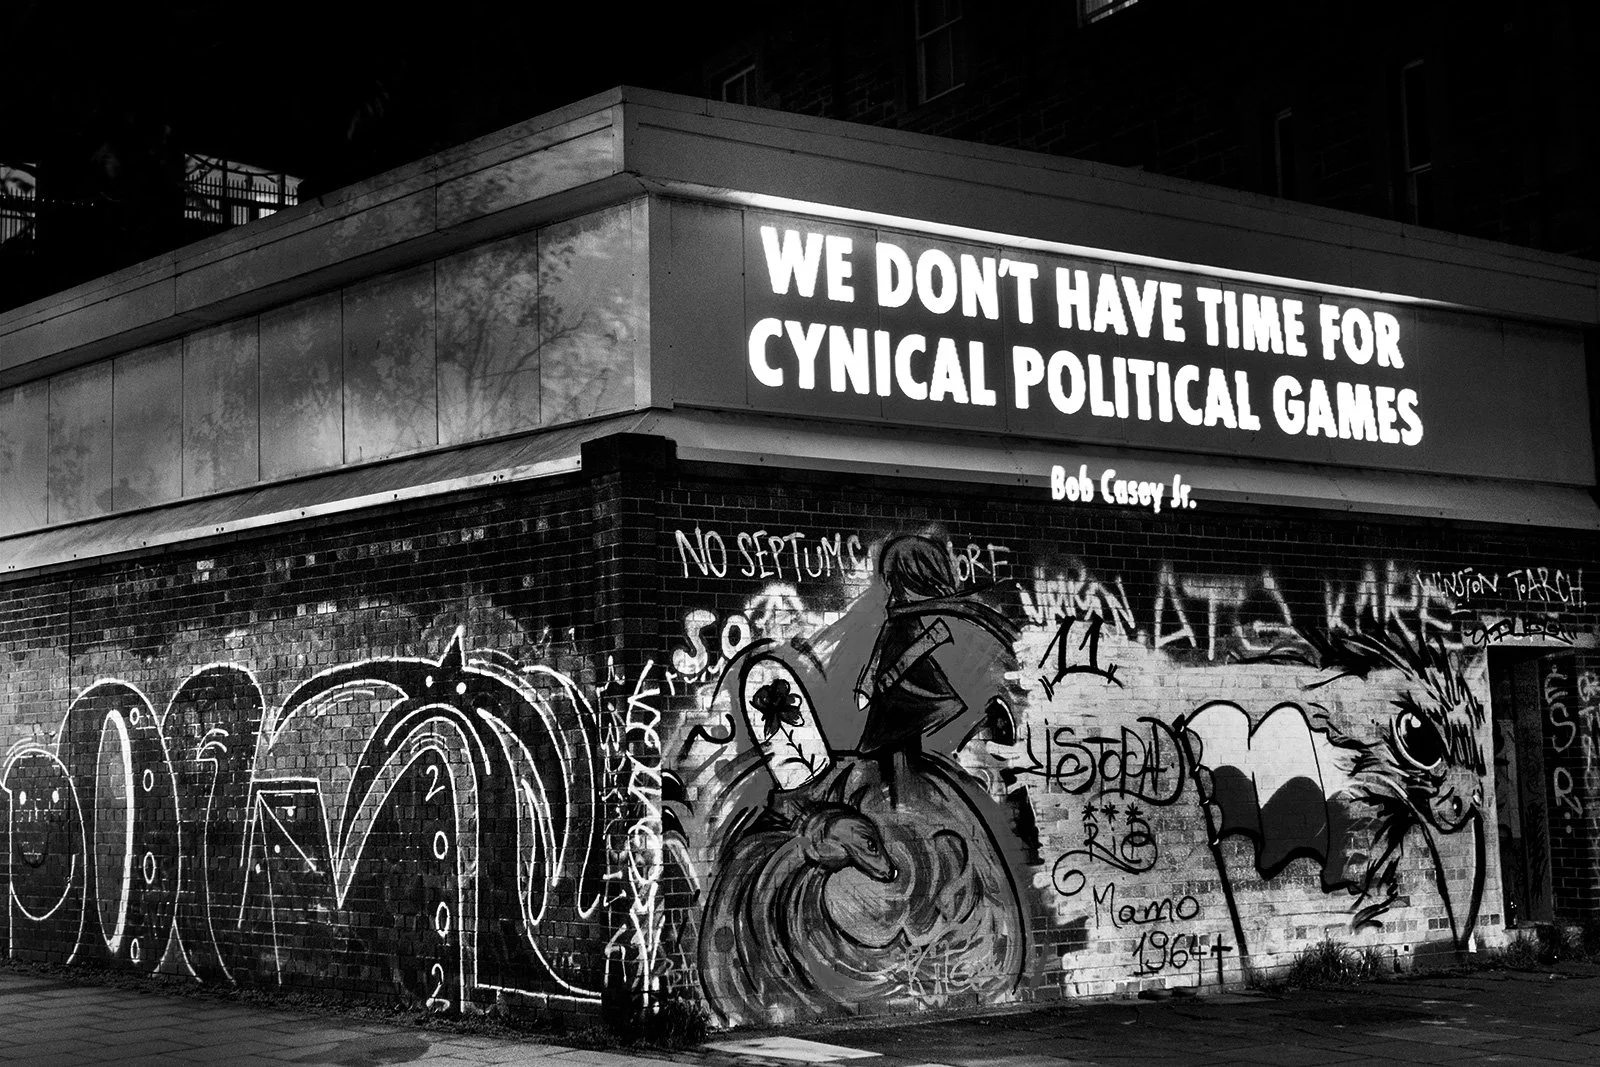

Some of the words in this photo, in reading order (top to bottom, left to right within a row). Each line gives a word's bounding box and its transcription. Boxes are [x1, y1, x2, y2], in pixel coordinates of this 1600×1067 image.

[760, 226, 854, 303] WE
[875, 242, 1039, 324] DON'T
[1056, 267, 1185, 342] HAVE
[1196, 287, 1307, 357] TIME
[1319, 304, 1404, 369] FOR
[748, 317, 996, 406] CYNICAL
[1012, 345, 1261, 431] POLITICAL
[1273, 375, 1423, 446] GAMES
[1051, 464, 1095, 503] Bob
[1101, 469, 1165, 514] Casey
[1170, 474, 1197, 509] Jr.
[675, 527, 727, 579] NO
